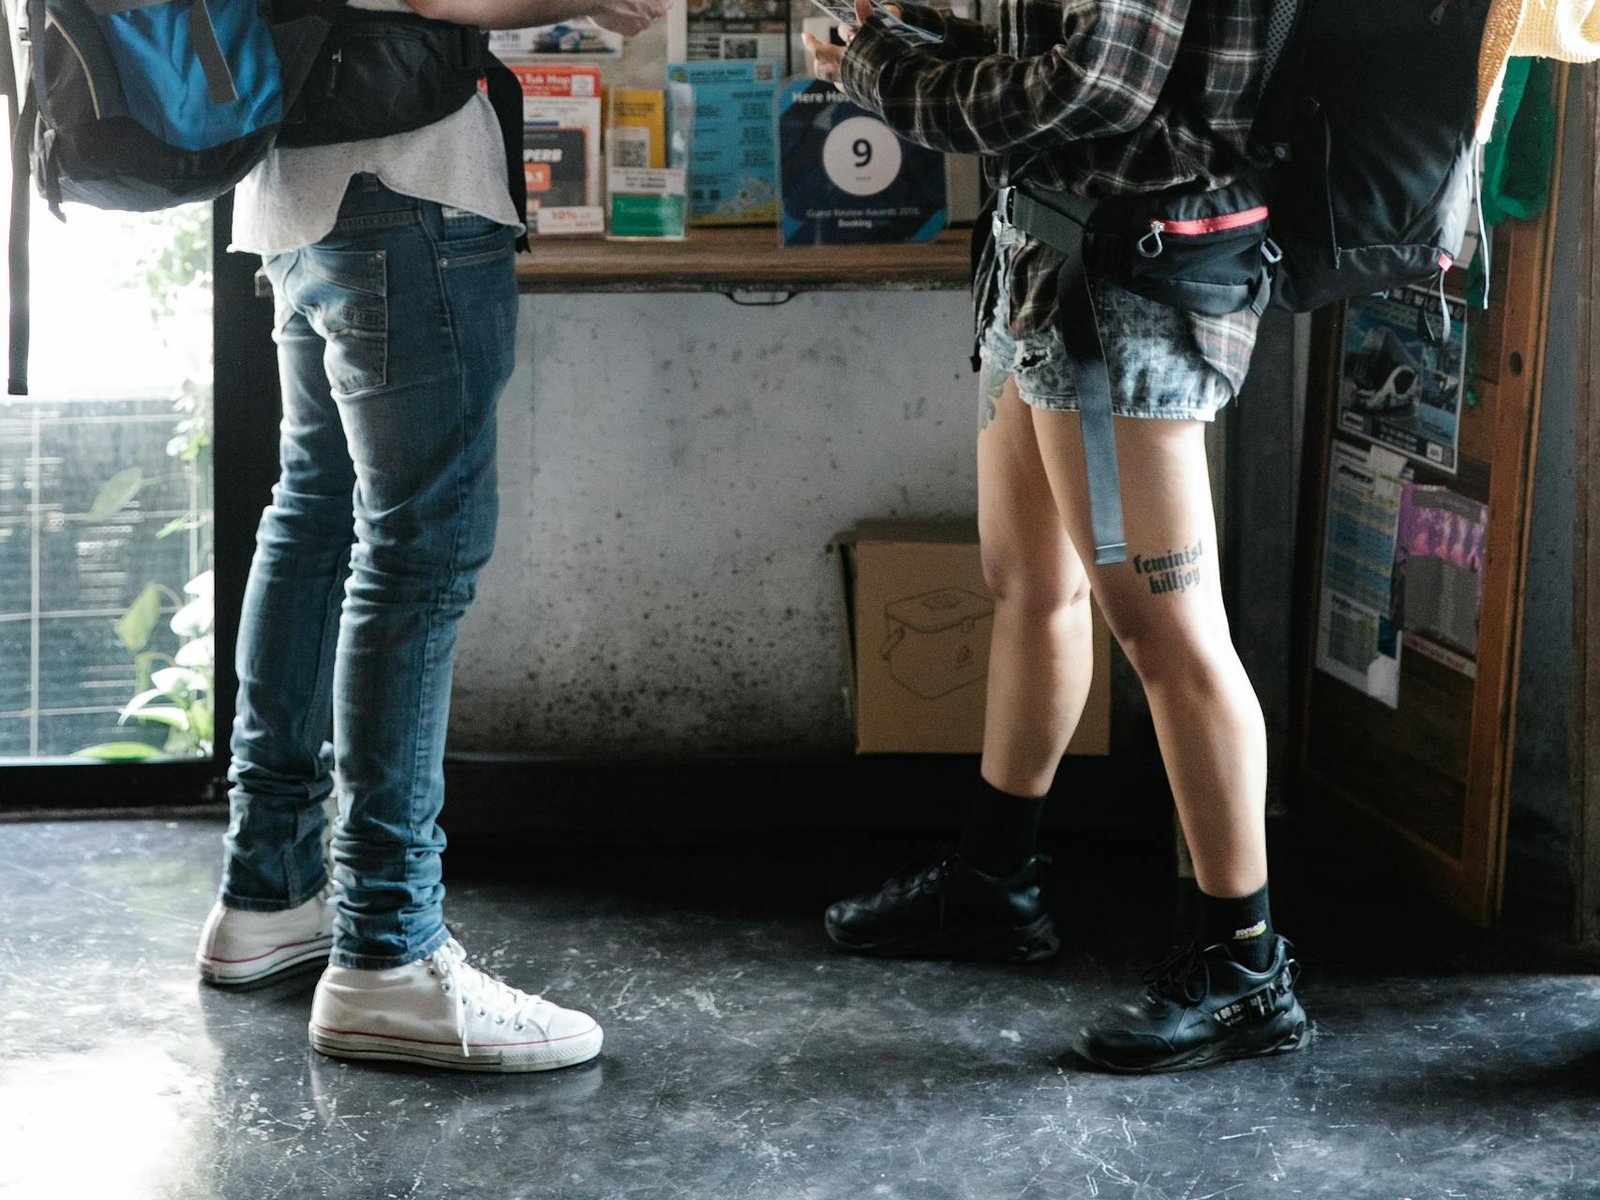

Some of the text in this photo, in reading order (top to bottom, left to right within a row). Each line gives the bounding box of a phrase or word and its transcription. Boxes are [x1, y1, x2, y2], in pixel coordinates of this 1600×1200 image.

[792, 91, 824, 103] Here
[853, 138, 872, 167] 9
[1133, 539, 1203, 574] feminist
